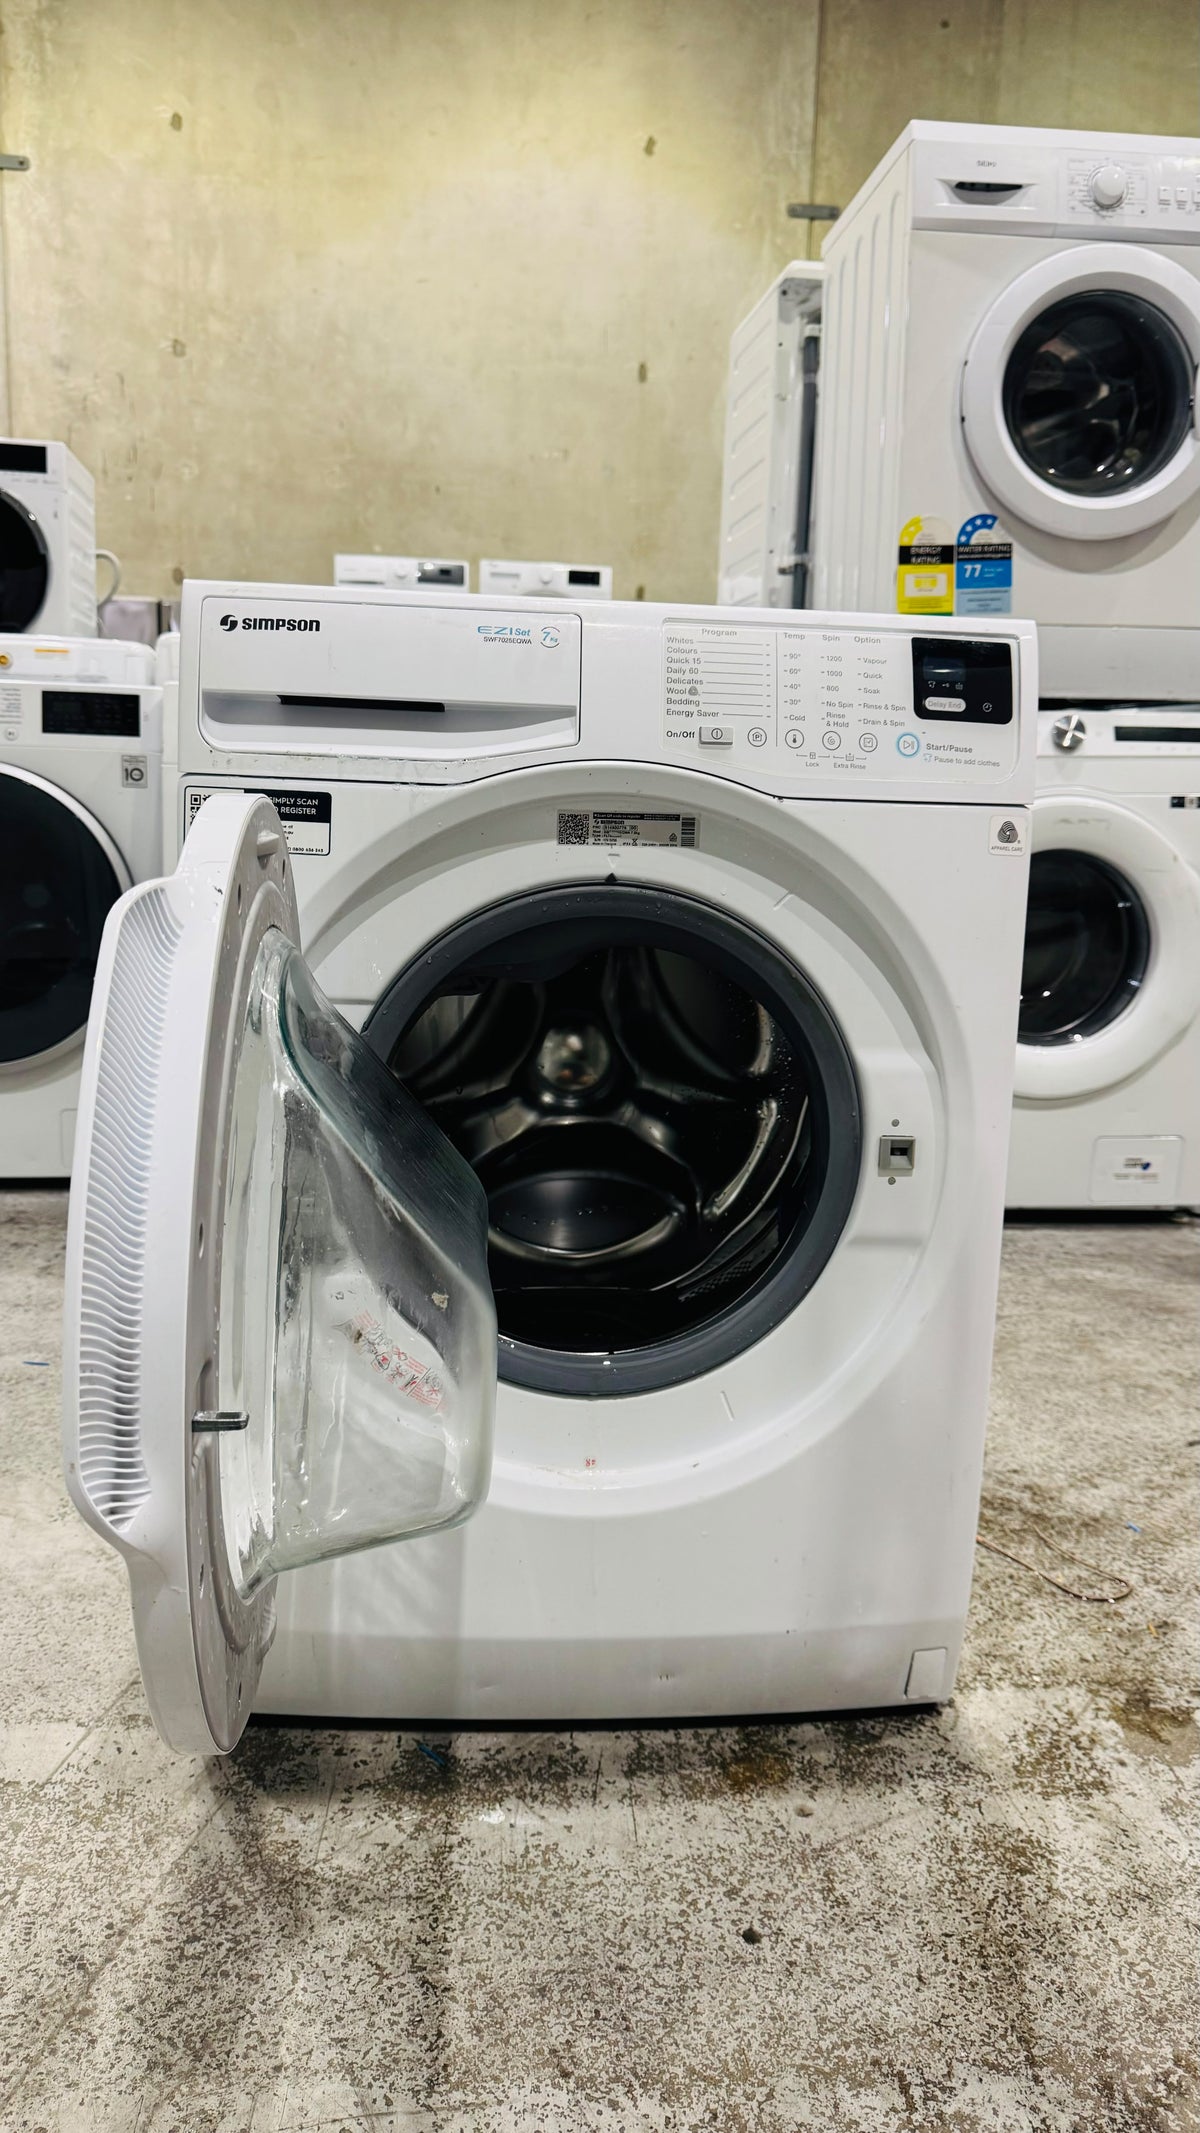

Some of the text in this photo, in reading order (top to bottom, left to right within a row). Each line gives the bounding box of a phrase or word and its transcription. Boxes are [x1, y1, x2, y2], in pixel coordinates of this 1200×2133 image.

[964, 564, 982, 578] 77
[241, 617, 321, 632] SIMPSON
[542, 631, 551, 642] 7
[701, 628, 738, 637] Program
[783, 632, 806, 640] Temp
[666, 636, 694, 645] Whites
[822, 634, 841, 642] Spin
[853, 636, 881, 645] Option
[666, 646, 698, 655] Colours
[666, 656, 690, 664] Quick
[826, 655, 843, 663] 1200
[862, 657, 888, 666] Vapour
[666, 666, 699, 676] Daily 60
[826, 670, 843, 678] 1000
[862, 672, 884, 680] Quick
[666, 677, 704, 686] Delicates
[666, 687, 687, 695] Wool
[826, 685, 840, 693] 800
[862, 687, 881, 695] Soak
[666, 697, 700, 707] Bedding
[826, 700, 854, 710] No Spin
[927, 700, 947, 709] Delay
[862, 702, 883, 711] Rinse
[890, 704, 907, 713] Spin
[666, 708, 720, 718] Energy Saver
[826, 711, 846, 720] Rinse
[788, 714, 806, 722] Cold
[862, 718, 906, 728] Drain & Spin
[666, 730, 696, 739] On/Off
[926, 743, 973, 754] Start/Pause
[934, 755, 1001, 768] Pause to add clothes
[850, 763, 867, 771] Rinse
[124, 767, 145, 782] 10
[281, 807, 317, 815] REGISTER
